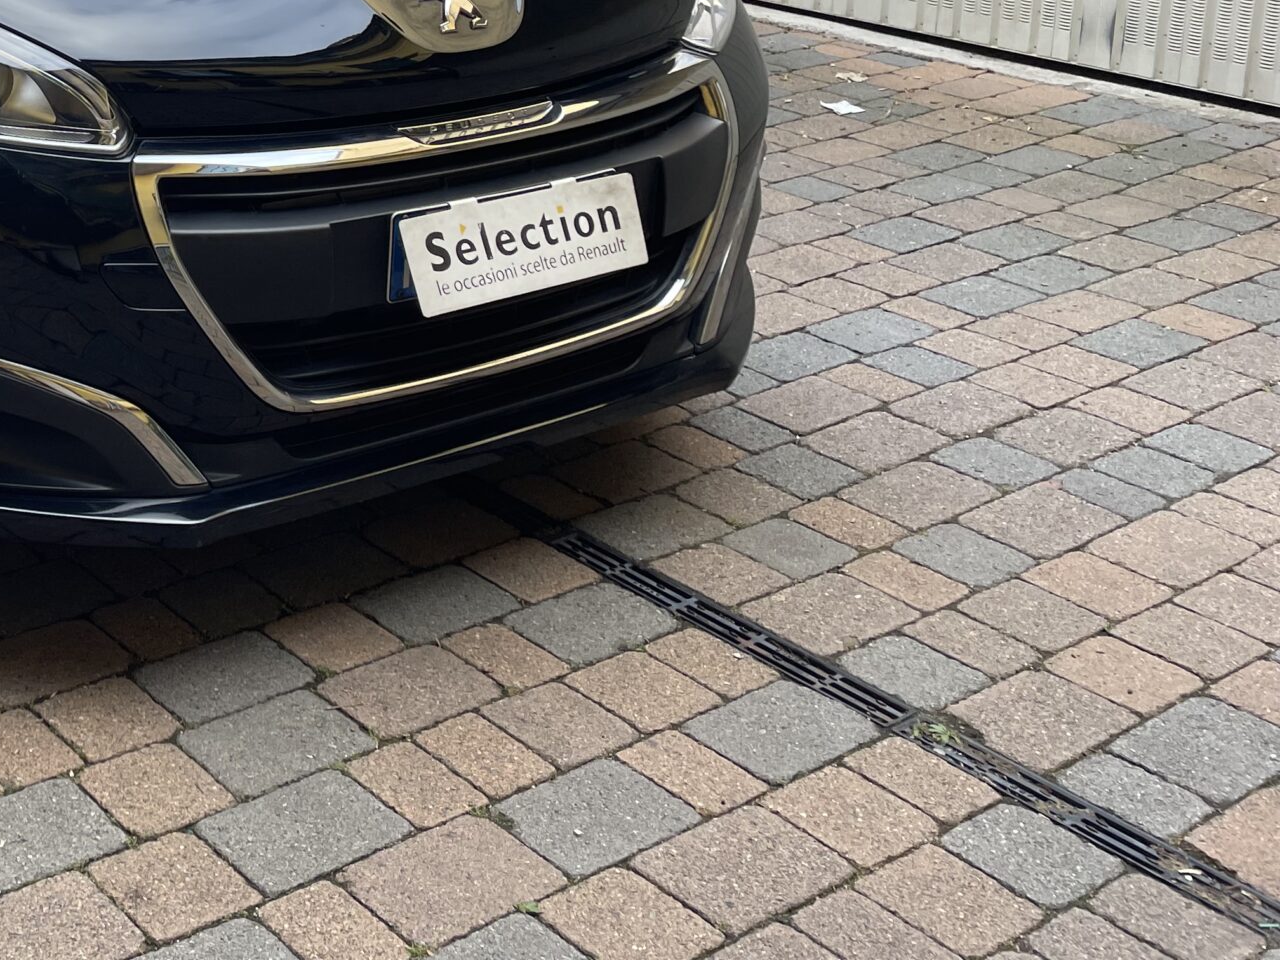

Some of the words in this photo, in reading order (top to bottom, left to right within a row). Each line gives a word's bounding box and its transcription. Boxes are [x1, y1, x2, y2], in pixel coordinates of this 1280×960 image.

[429, 108, 528, 134] PEUGEOT
[435, 280, 450, 296] le
[453, 262, 518, 292] occasioni
[520, 255, 557, 276] scelte
[560, 249, 576, 266] da
[577, 237, 628, 262] Renault
